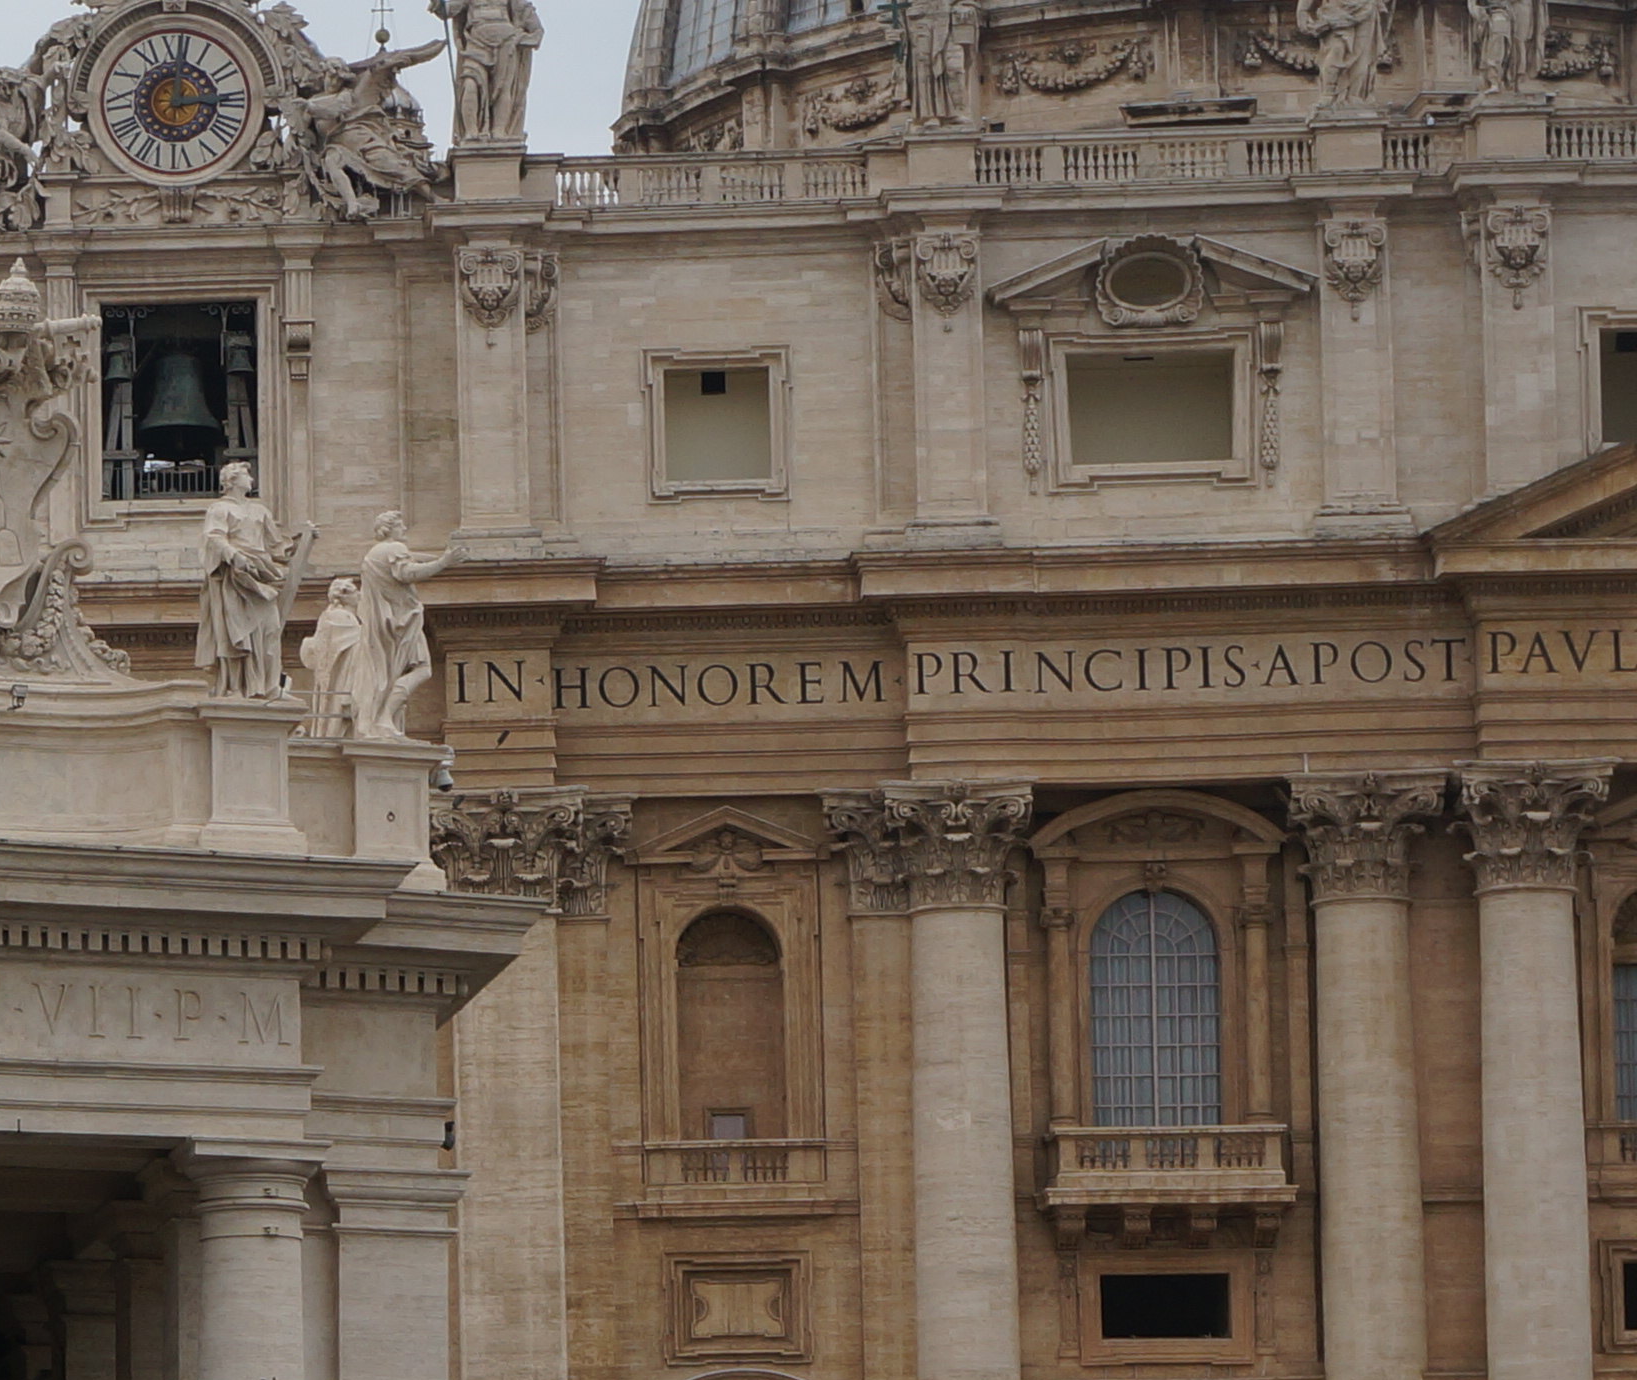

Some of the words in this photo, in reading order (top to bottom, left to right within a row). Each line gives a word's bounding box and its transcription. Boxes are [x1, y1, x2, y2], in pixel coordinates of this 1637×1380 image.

[453, 661, 525, 704] IN
[554, 660, 888, 709] HONOREM
[913, 644, 1246, 695] PRINCIPIS
[1261, 637, 1468, 688] APOST
[33, 982, 143, 1041] VII
